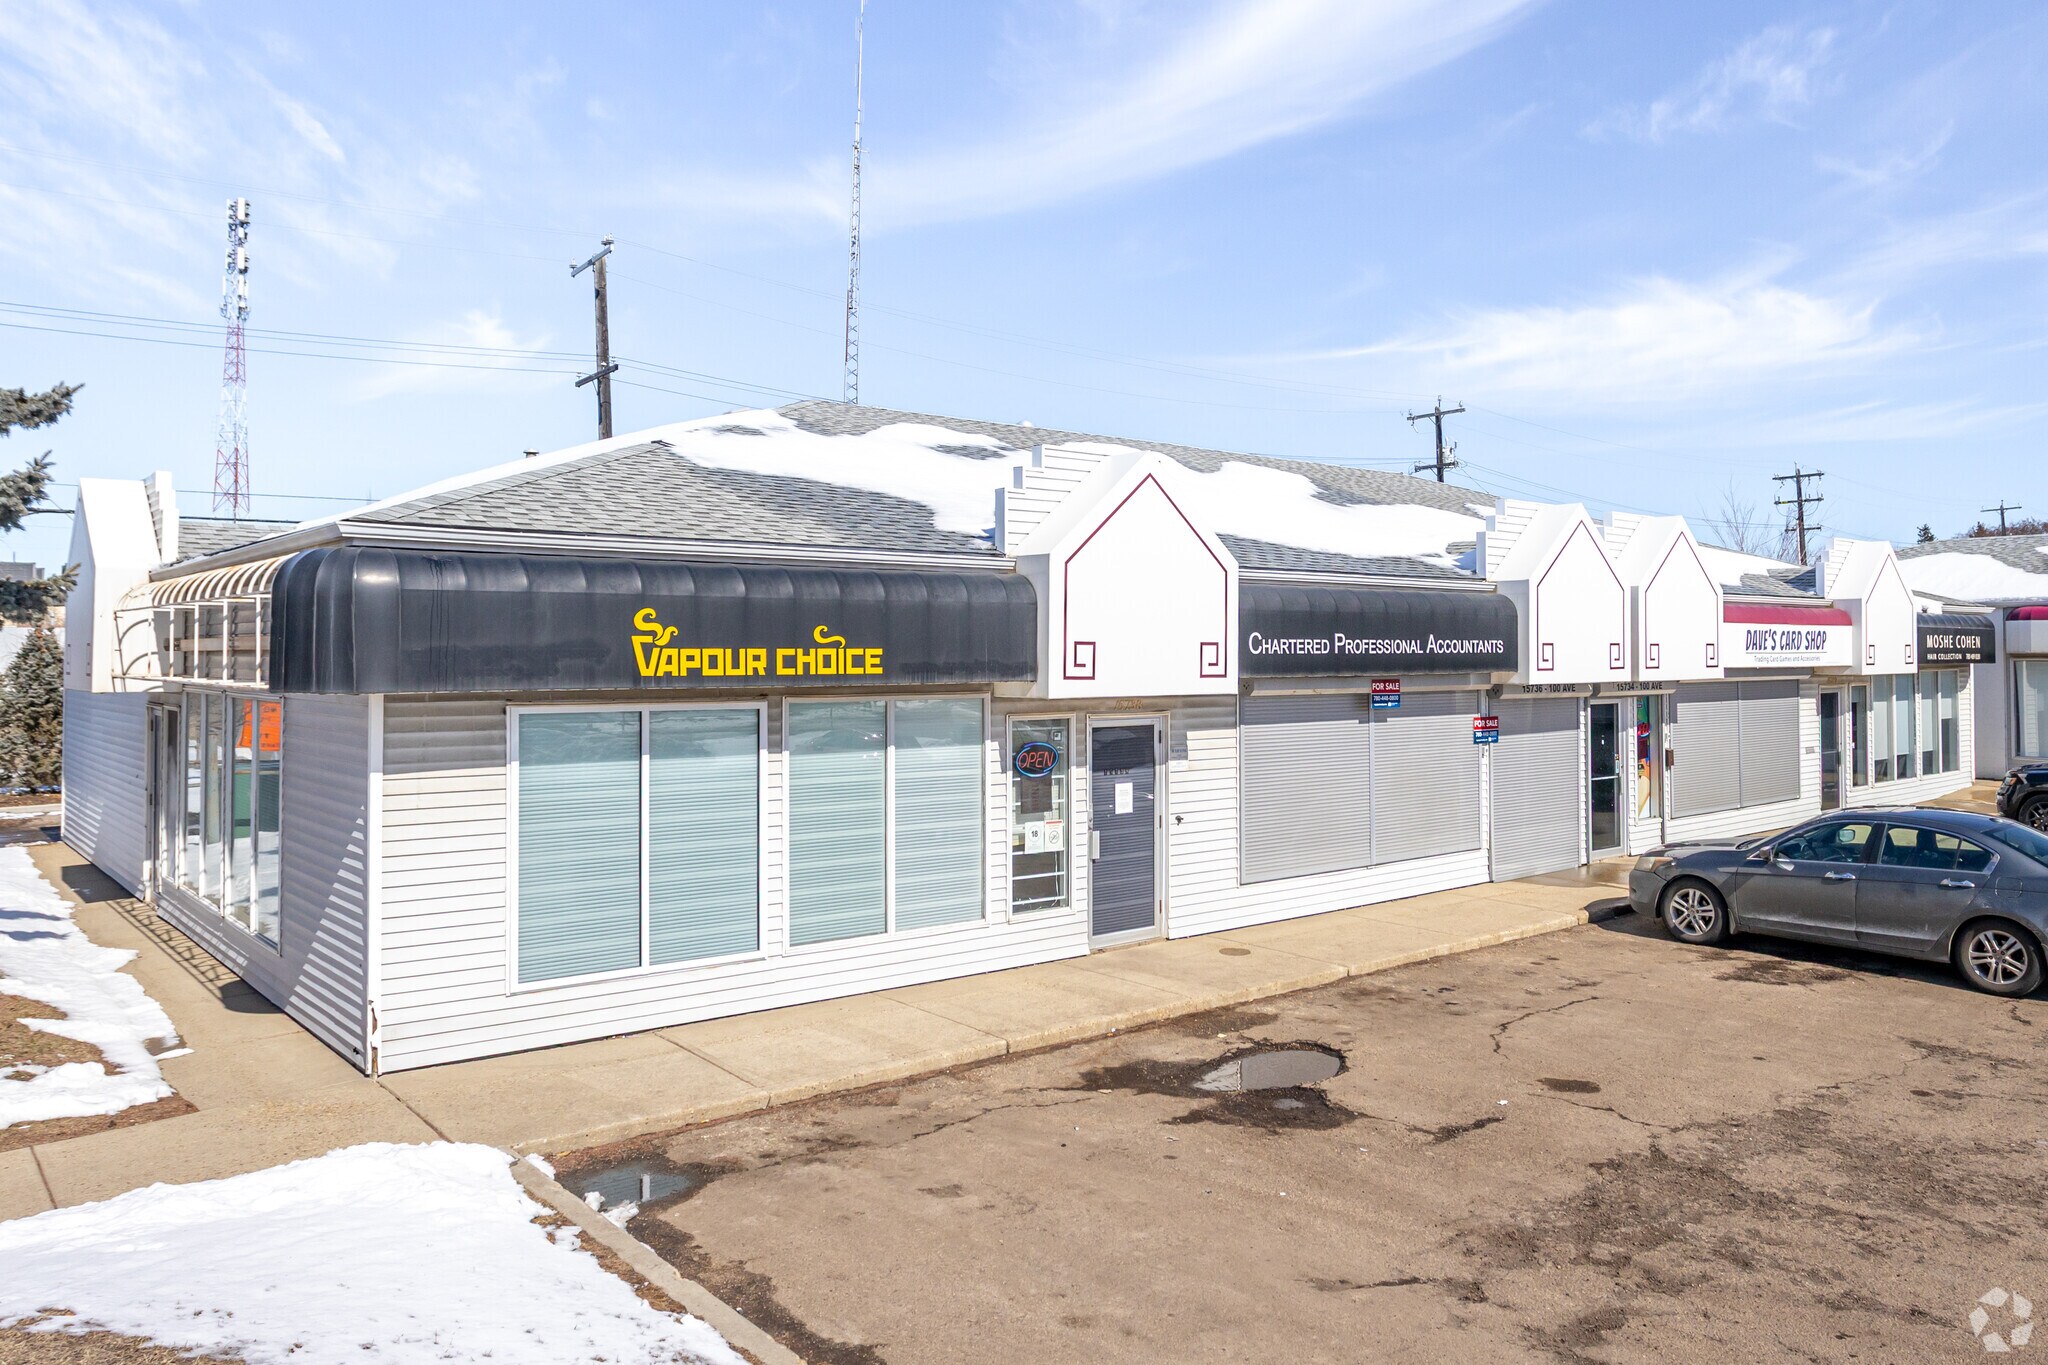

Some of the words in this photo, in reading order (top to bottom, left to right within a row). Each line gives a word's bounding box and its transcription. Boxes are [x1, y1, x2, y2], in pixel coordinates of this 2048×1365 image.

[1248, 632, 1330, 655] CHARTERED
[1334, 632, 1424, 654] PROFESSIONAL
[1426, 633, 1504, 654] ACCOUNTANTS
[1745, 628, 1777, 651] DAVE'S
[1780, 630, 1802, 651] CARD
[1805, 630, 1827, 651] SHOP
[1926, 634, 1954, 649] MOSHE
[1955, 635, 1981, 649] COHEN
[631, 632, 767, 677] VAPOUR
[776, 644, 883, 676] CHOICE
[1372, 682, 1384, 691] FOR
[1385, 682, 1400, 690] SALE
[1522, 684, 1543, 693] 15736
[1549, 684, 1561, 693] 100
[1562, 683, 1576, 692] AVE
[1616, 682, 1635, 691] 15734
[1639, 681, 1650, 690] 100
[1651, 681, 1663, 690] AVE
[1474, 719, 1485, 728] FOR
[1486, 719, 1498, 727] SALE
[1018, 751, 1055, 769] OPEN
